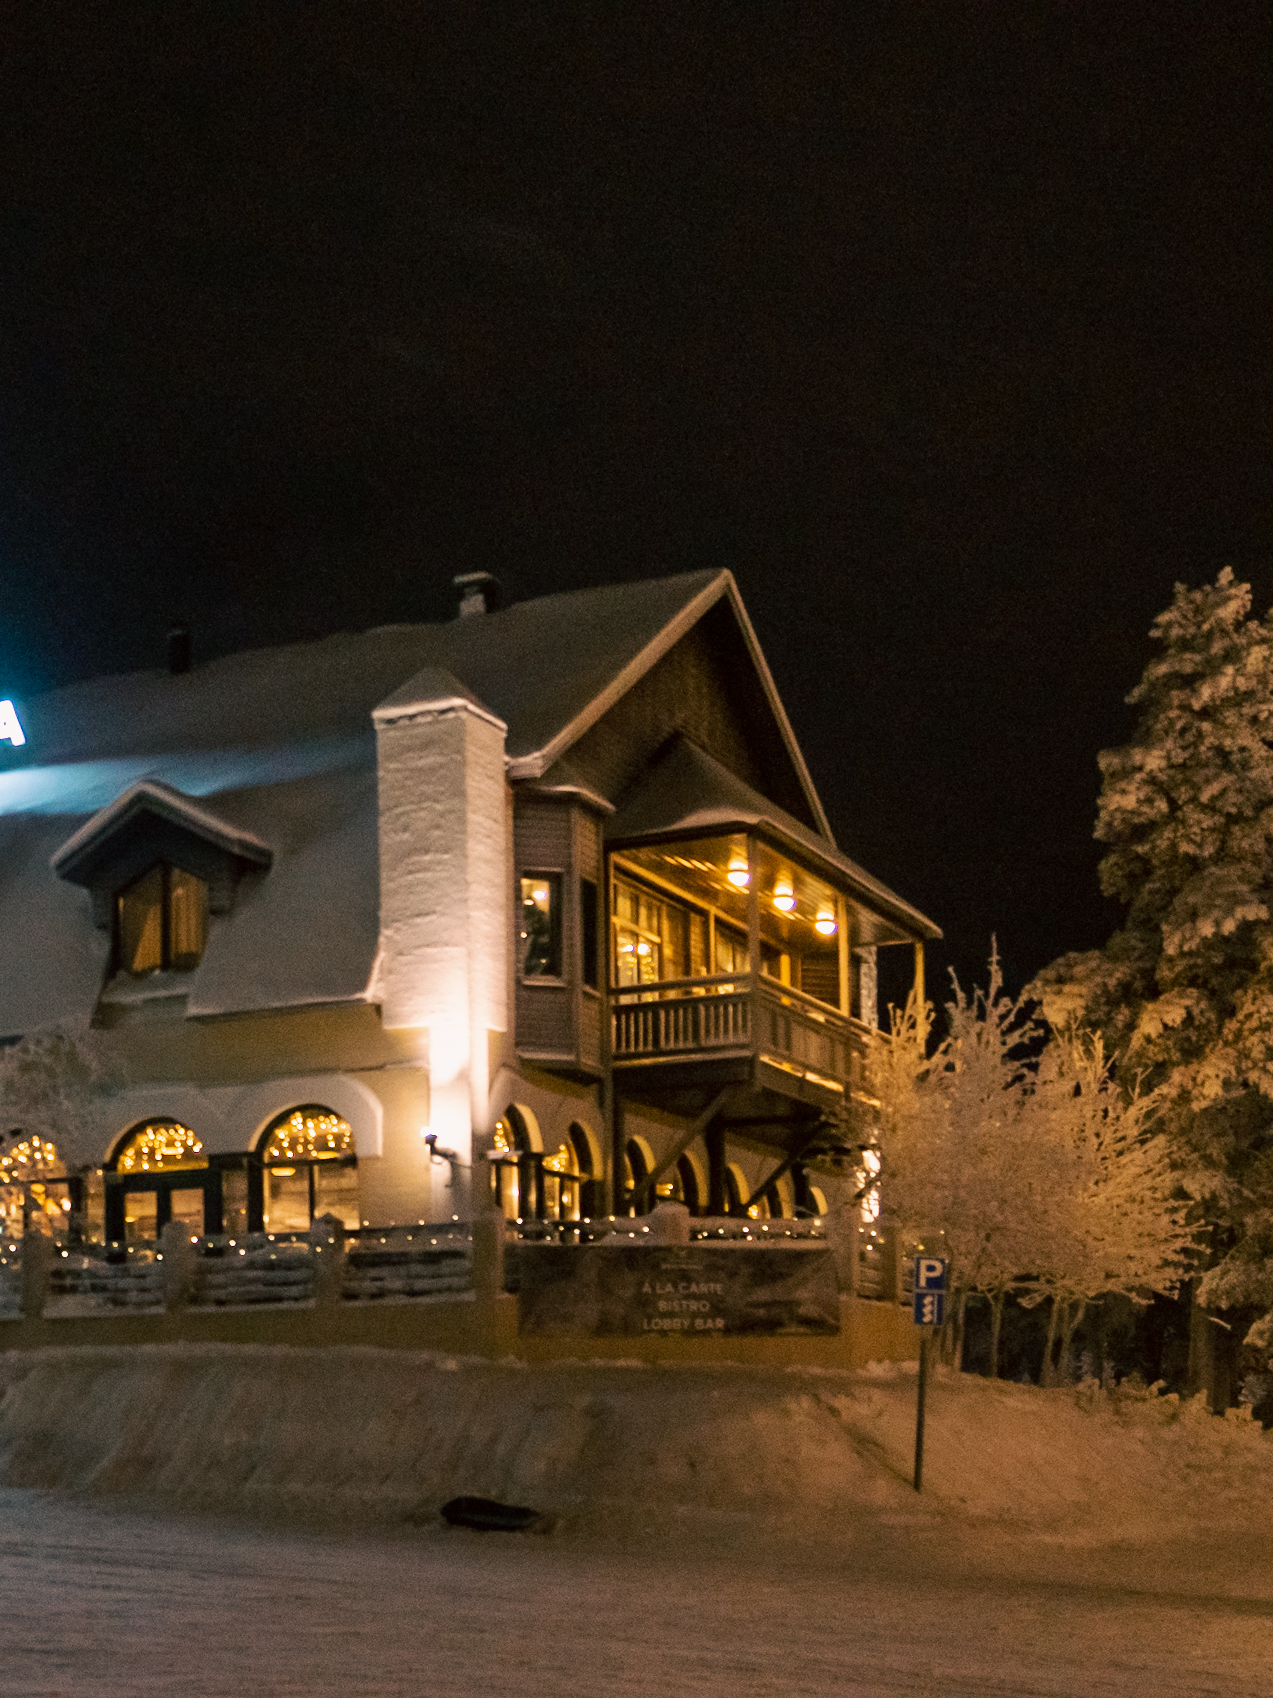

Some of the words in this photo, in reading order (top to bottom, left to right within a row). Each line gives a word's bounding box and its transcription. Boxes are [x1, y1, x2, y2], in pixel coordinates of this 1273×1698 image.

[919, 1259, 944, 1288] P
[655, 1282, 675, 1294] LA
[677, 1281, 724, 1295] CARTE
[658, 1300, 710, 1312] BISTRO
[643, 1318, 690, 1330] LOBBY
[694, 1317, 725, 1330] BAR
